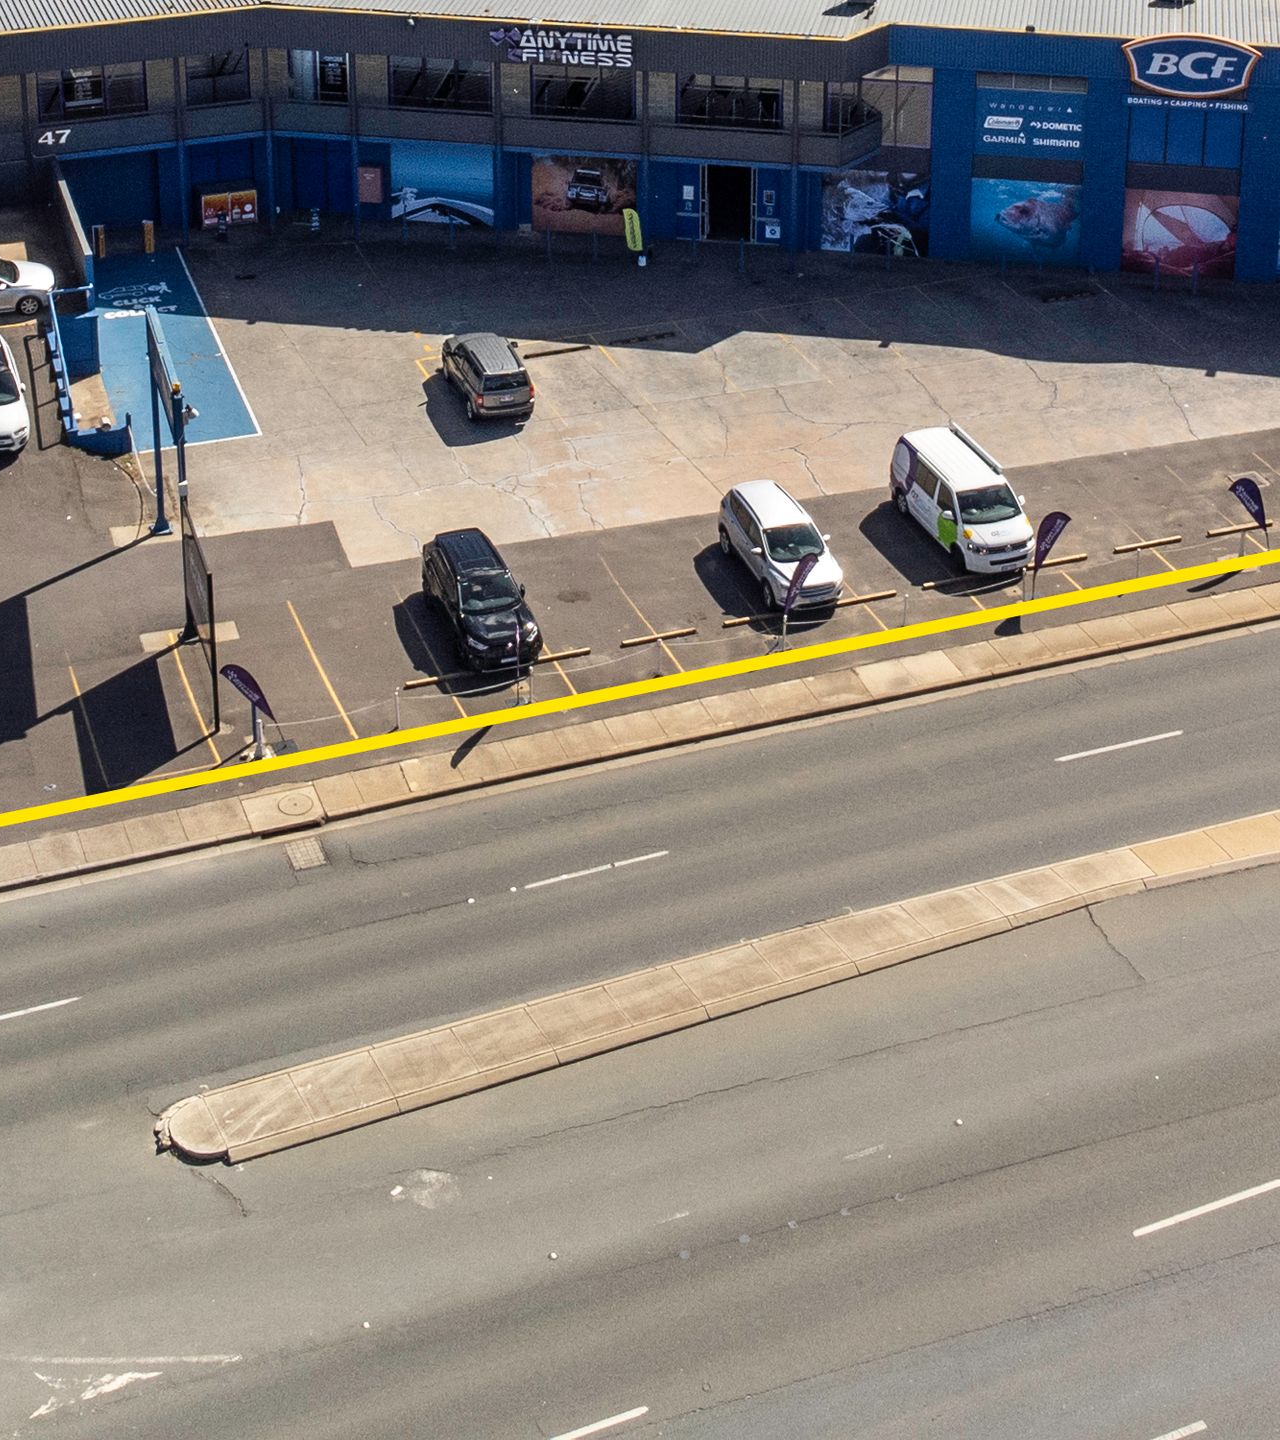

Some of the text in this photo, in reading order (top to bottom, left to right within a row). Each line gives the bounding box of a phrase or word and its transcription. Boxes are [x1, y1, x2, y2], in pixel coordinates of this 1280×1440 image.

[520, 30, 632, 52] ANYTIME
[1146, 52, 1237, 79] BCF
[1170, 100, 1207, 108] CAMPING
[1215, 103, 1248, 111] FISHING
[1042, 122, 1082, 131] DOMETIC
[38, 129, 71, 145] 47
[983, 135, 1026, 144] GARMIN
[1033, 138, 1080, 148] SHIMANO
[113, 296, 162, 306] CLICK
